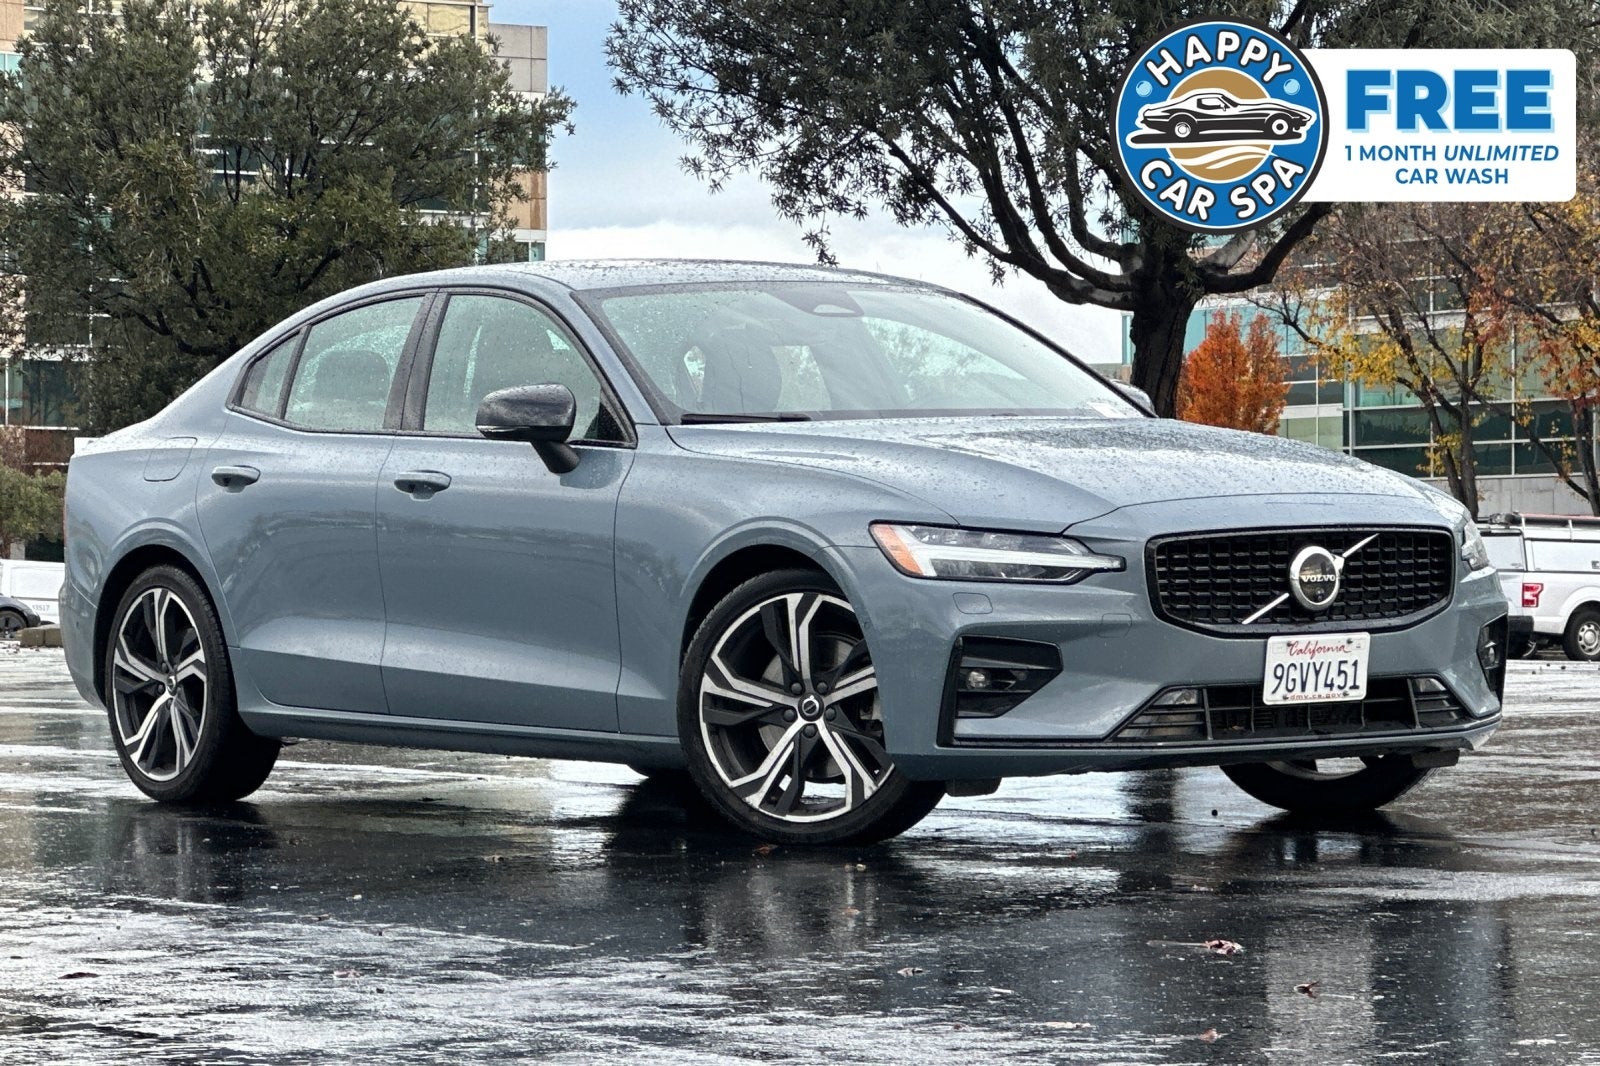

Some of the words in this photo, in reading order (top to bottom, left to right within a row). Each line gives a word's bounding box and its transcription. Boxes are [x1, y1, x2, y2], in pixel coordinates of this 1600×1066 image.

[1301, 574, 1336, 583] VOLVO
[1288, 640, 1352, 660] California
[1271, 659, 1360, 695] 9GVY451
